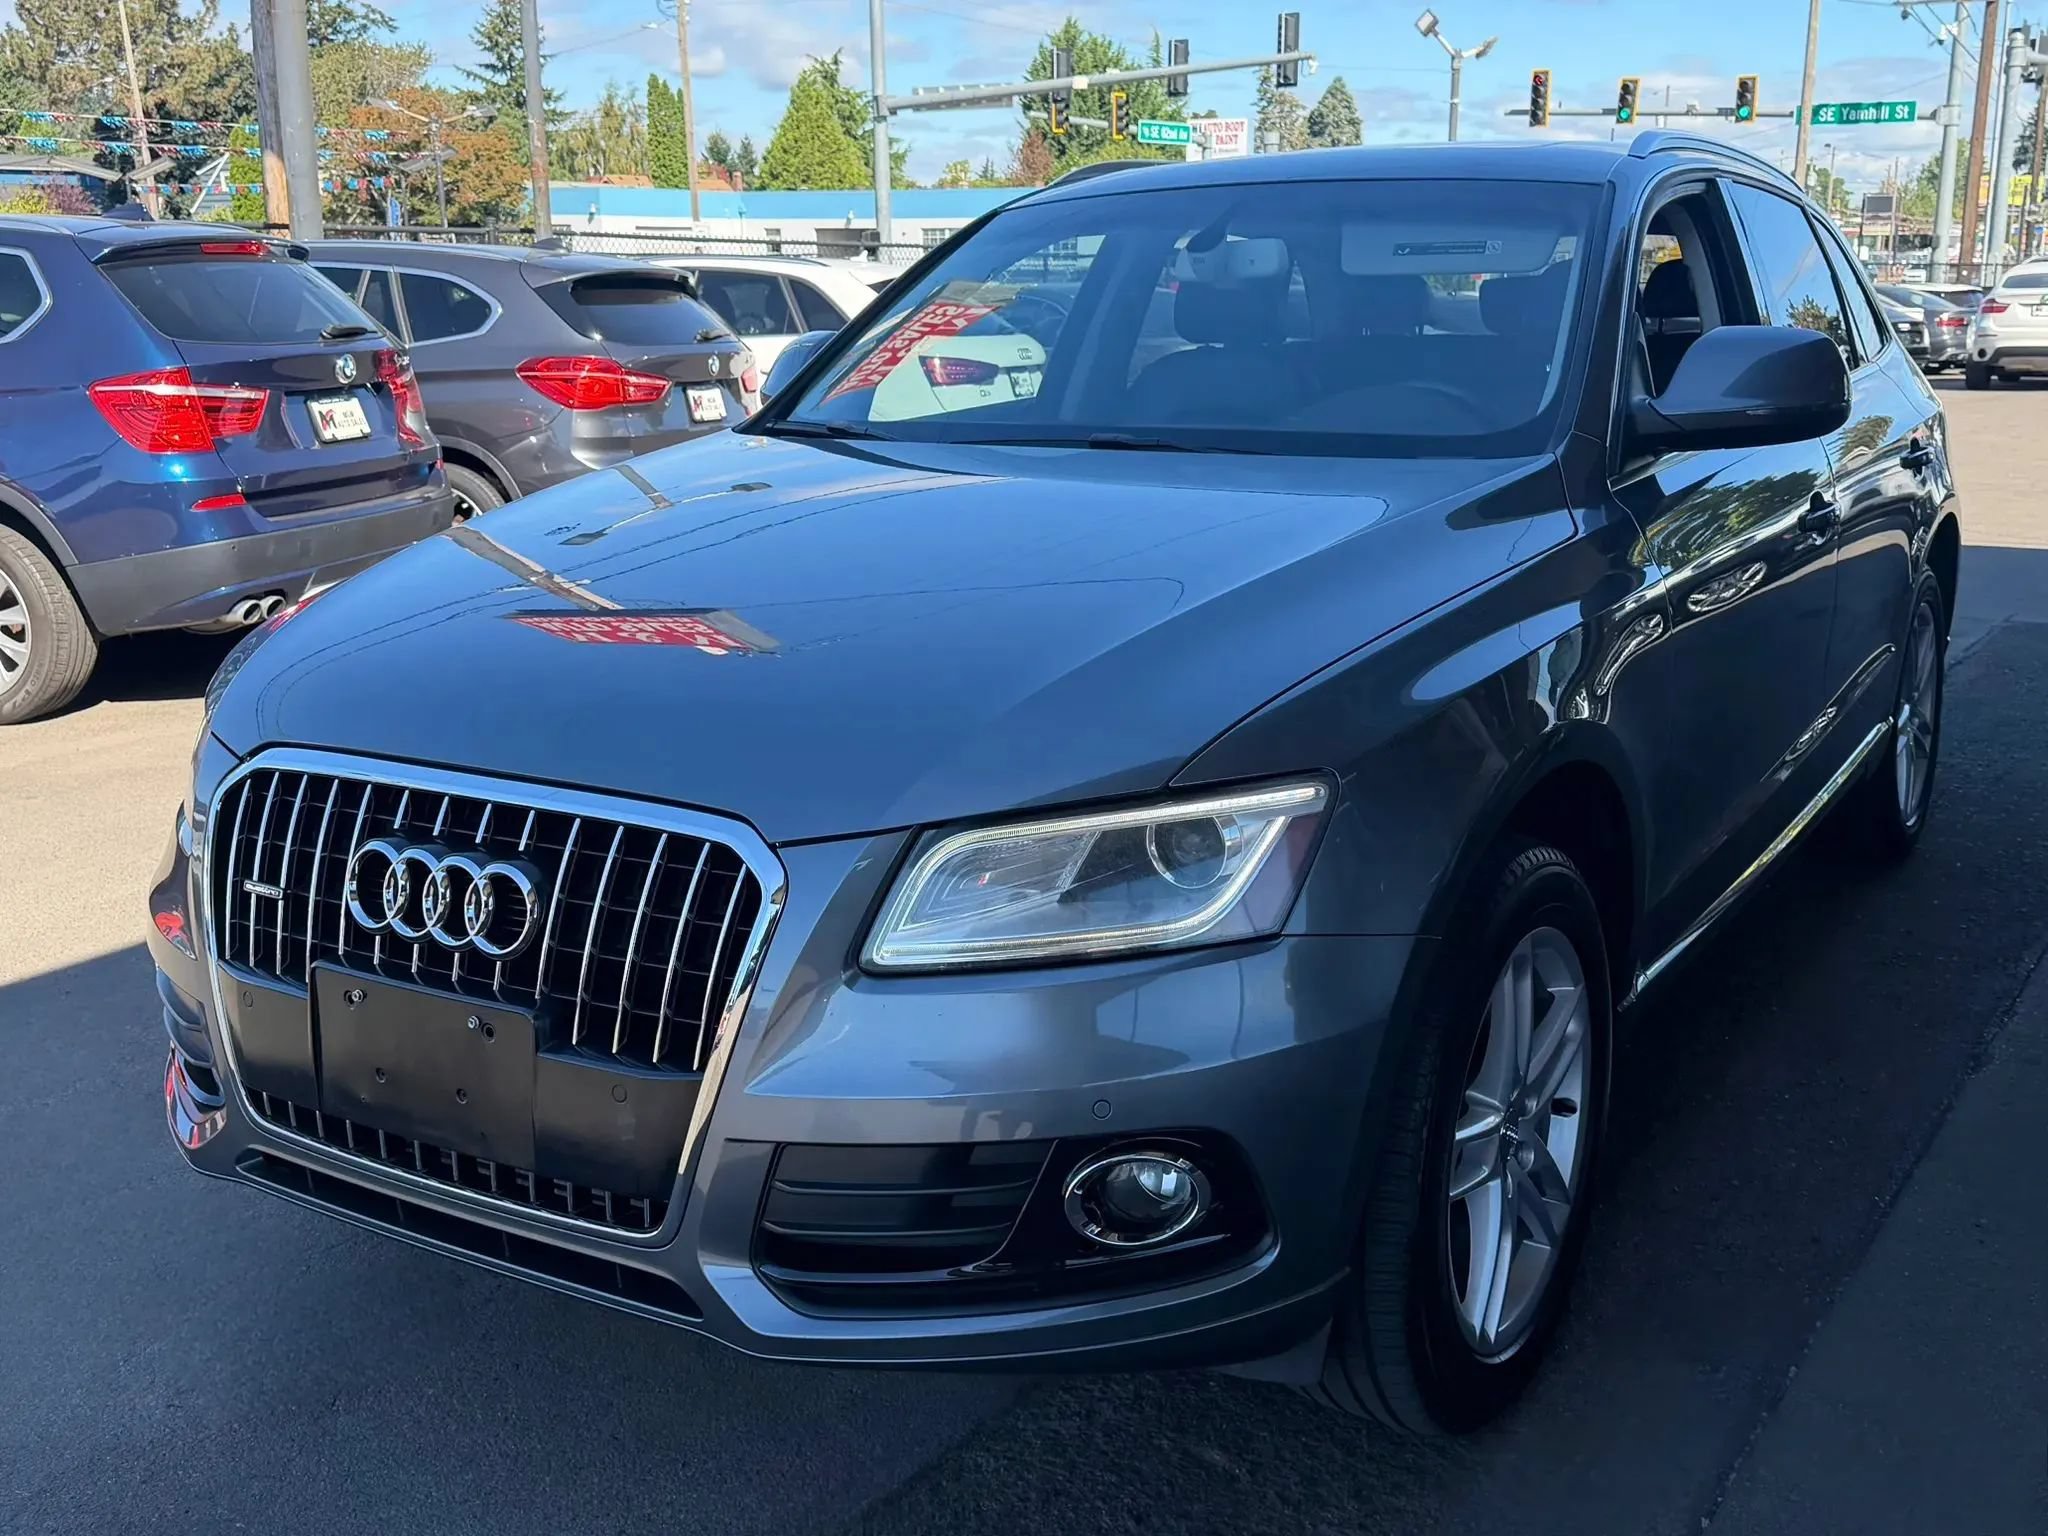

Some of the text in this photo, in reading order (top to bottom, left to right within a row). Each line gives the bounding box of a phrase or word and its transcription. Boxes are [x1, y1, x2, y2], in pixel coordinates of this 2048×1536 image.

[1819, 104, 1909, 121] SE Yamhill St
